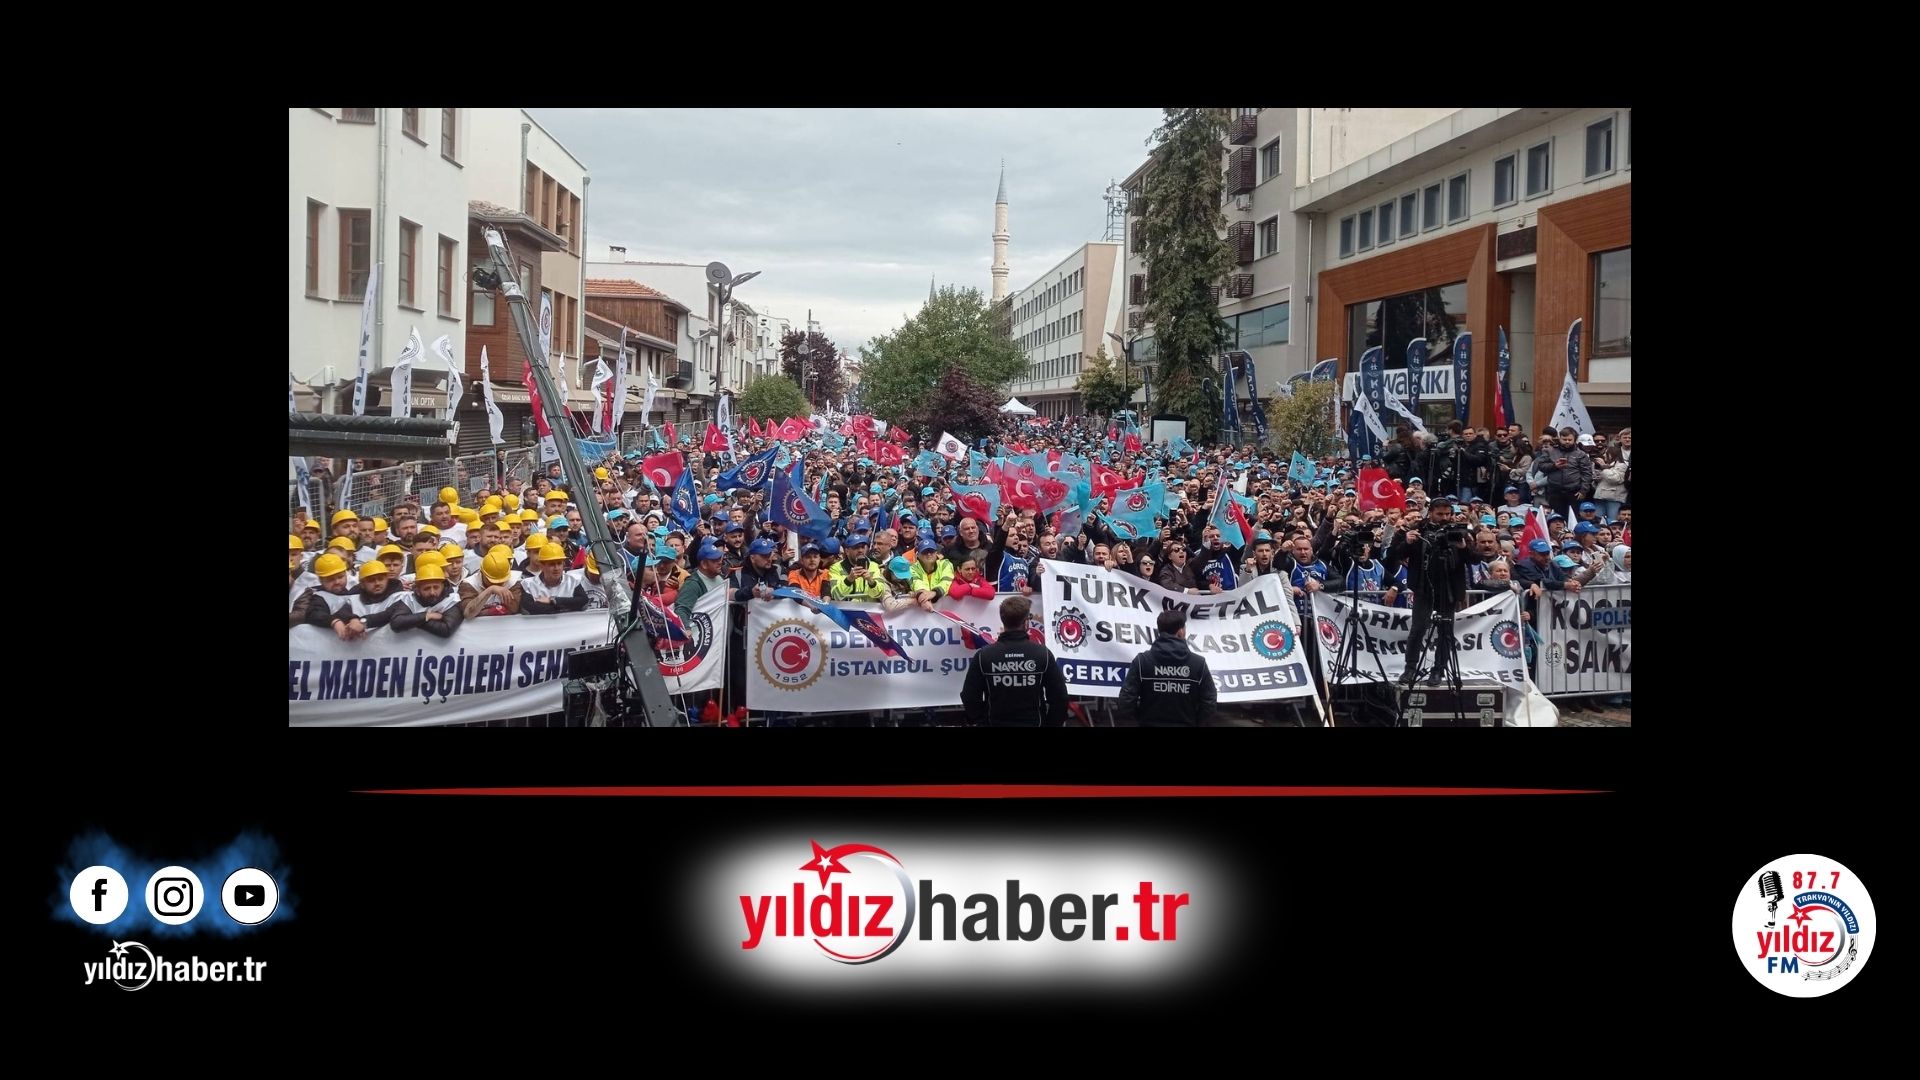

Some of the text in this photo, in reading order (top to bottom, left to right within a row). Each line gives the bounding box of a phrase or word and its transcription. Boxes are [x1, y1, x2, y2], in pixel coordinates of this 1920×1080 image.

[1056, 573, 1281, 620] TÜRK METAL
[317, 656, 408, 700] MADEN
[411, 645, 515, 705] İŞÇİLERİ
[830, 653, 975, 677] İSTANBUL ŞU
[1062, 663, 1130, 683] ÇERK
[775, 673, 808, 684] 1952
[1153, 681, 1191, 694] EDİRNE
